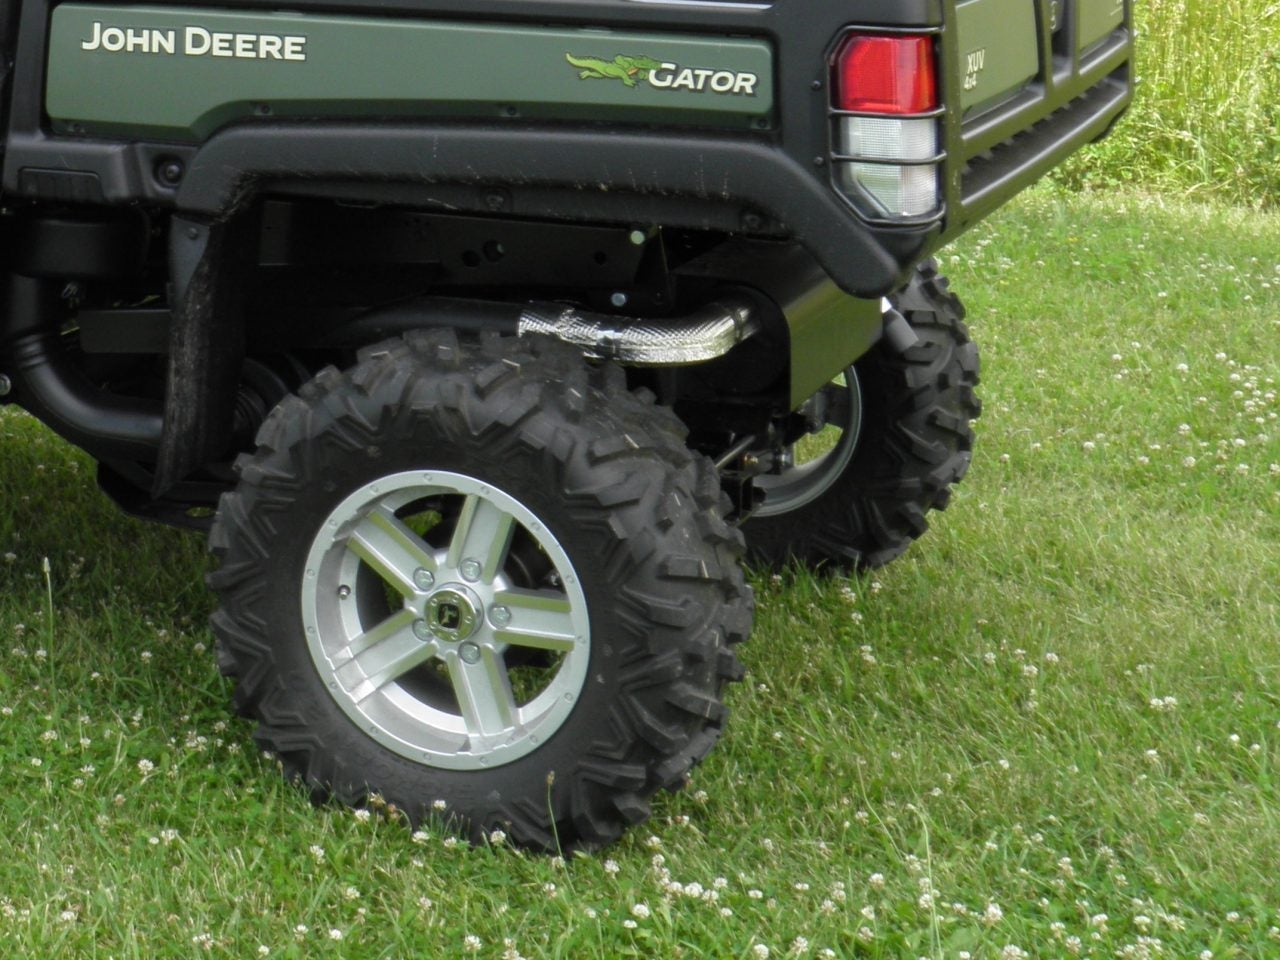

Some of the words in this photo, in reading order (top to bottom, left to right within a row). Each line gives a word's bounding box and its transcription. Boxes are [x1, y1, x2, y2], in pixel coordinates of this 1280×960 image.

[82, 22, 176, 54] JOHN
[185, 26, 306, 61] DEERE
[967, 49, 985, 74] XUV
[648, 62, 758, 94] GATOR
